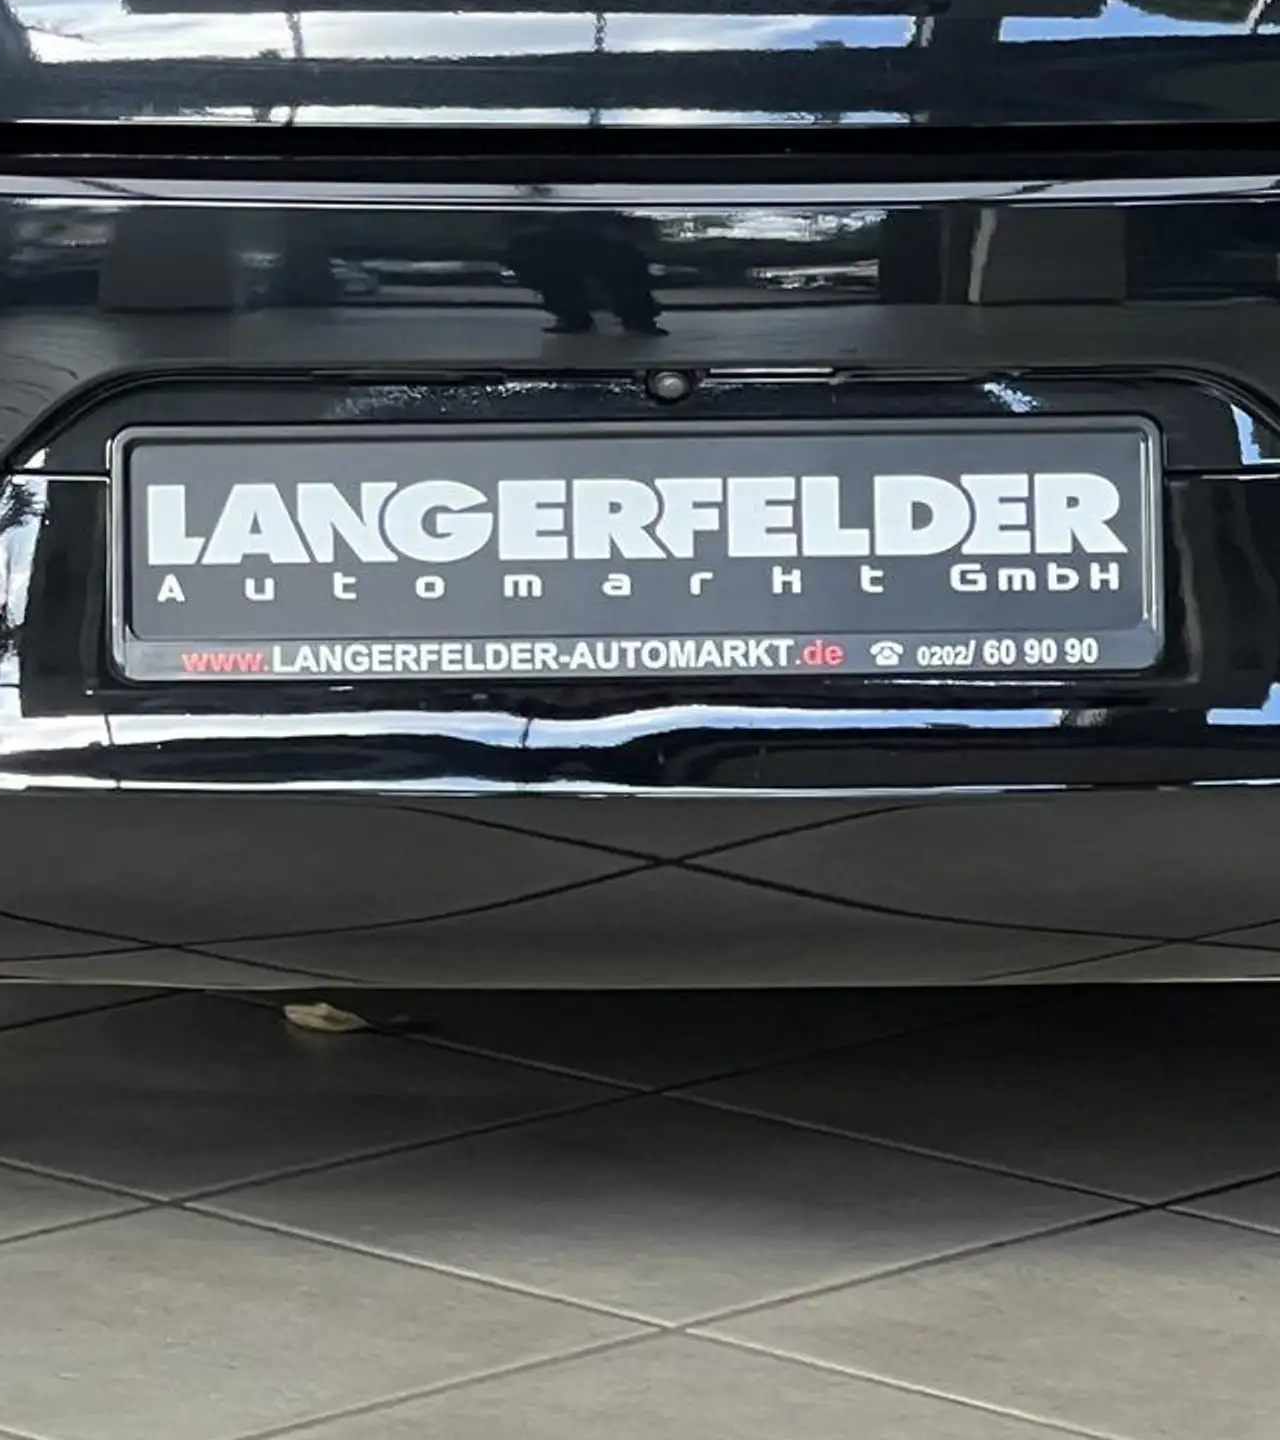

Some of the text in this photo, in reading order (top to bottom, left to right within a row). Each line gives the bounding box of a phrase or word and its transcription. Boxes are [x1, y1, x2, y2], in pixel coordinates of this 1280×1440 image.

[146, 472, 1130, 565] LANGERFELDER
[949, 561, 1120, 593] GmbH
[180, 637, 1100, 675] www.LANGERFELDER-AUTOMARKT.de 0202/ 60 90 90
